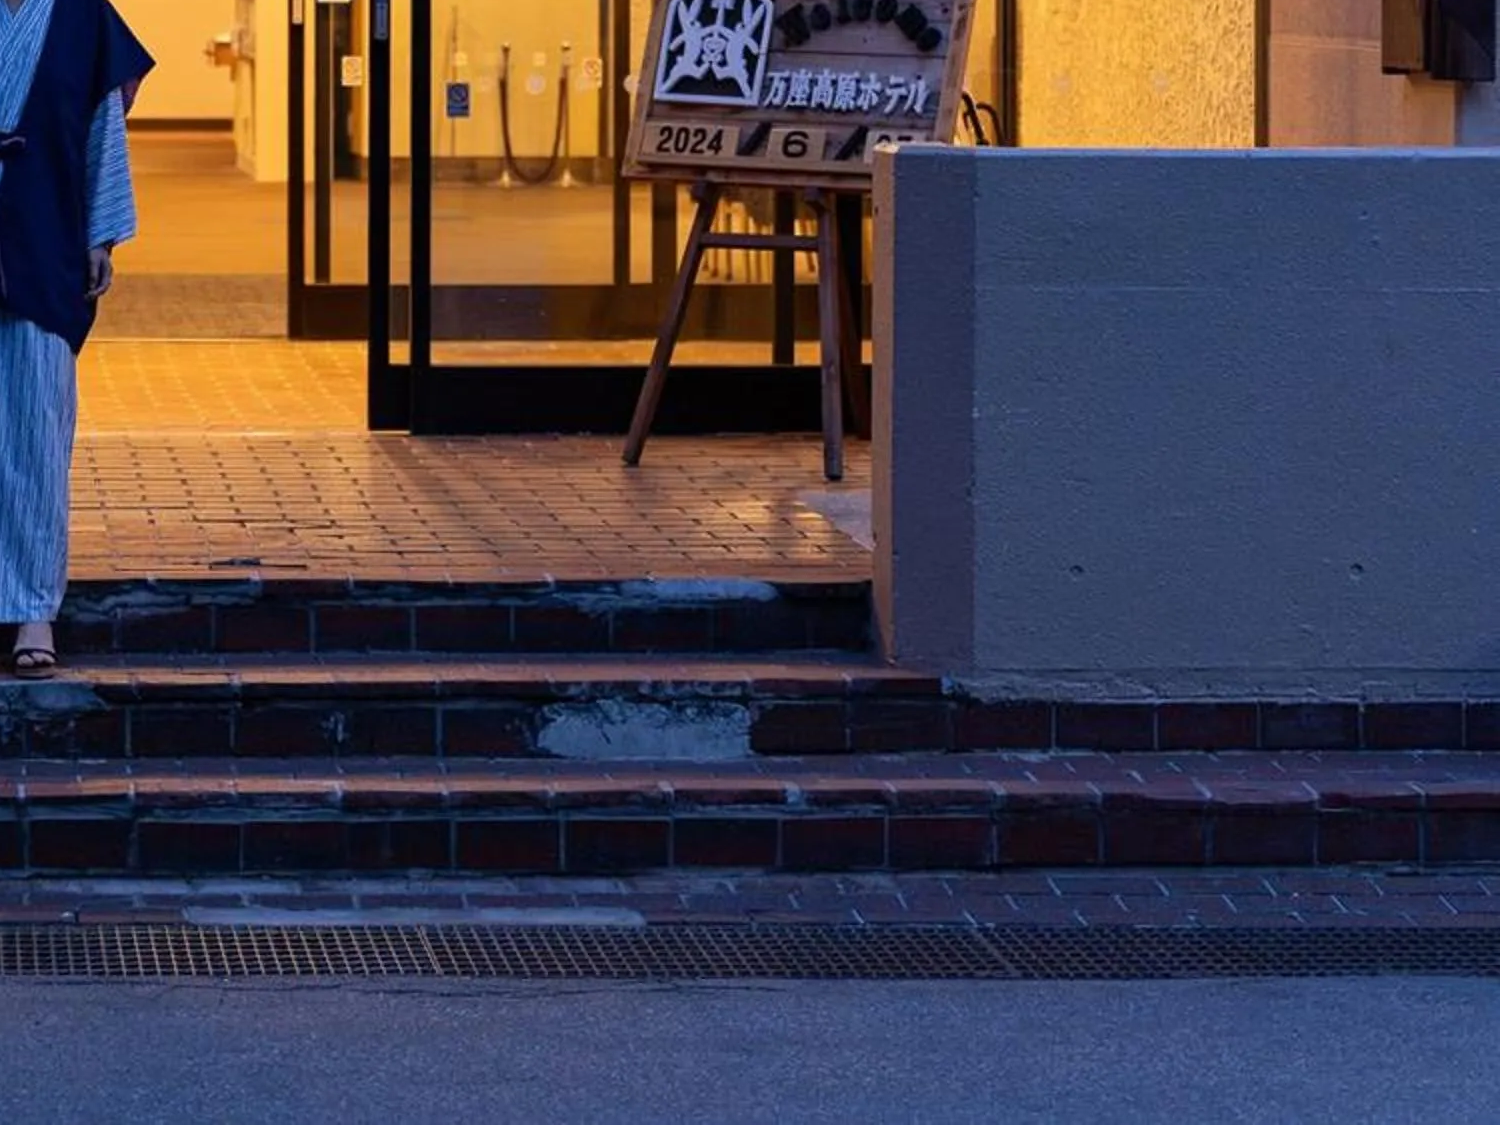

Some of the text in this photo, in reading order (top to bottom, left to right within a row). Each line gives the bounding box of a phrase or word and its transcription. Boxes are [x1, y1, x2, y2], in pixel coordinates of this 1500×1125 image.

[763, 72, 930, 115] 万座高原ホテル
[656, 126, 723, 154] 2024
[782, 131, 808, 158] 6
